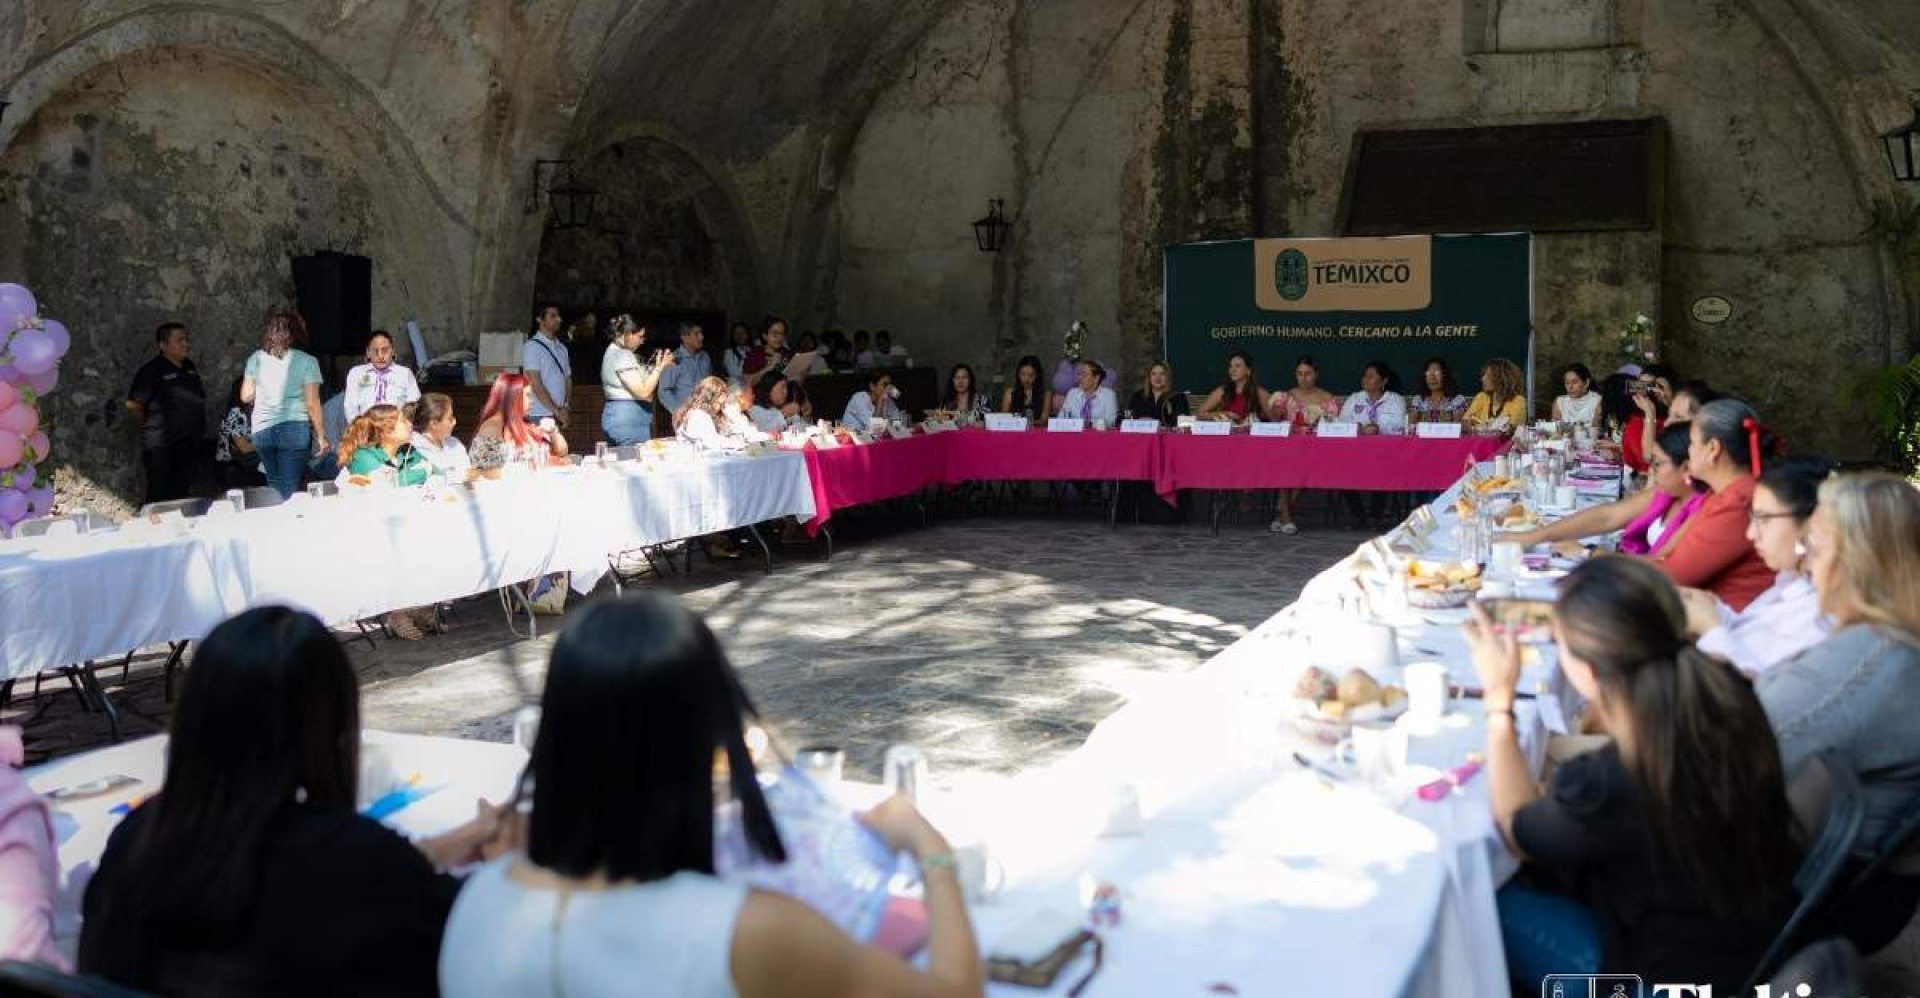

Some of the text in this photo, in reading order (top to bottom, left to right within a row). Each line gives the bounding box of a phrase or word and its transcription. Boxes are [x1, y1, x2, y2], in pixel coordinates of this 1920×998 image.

[1312, 263, 1410, 284] TEMIXCO
[1211, 325, 1275, 339] GOBIERNO
[1339, 325, 1400, 338] CERCANO
[1402, 325, 1412, 337] A
[1415, 325, 1431, 337] LA
[1435, 325, 1479, 337] GENTE
